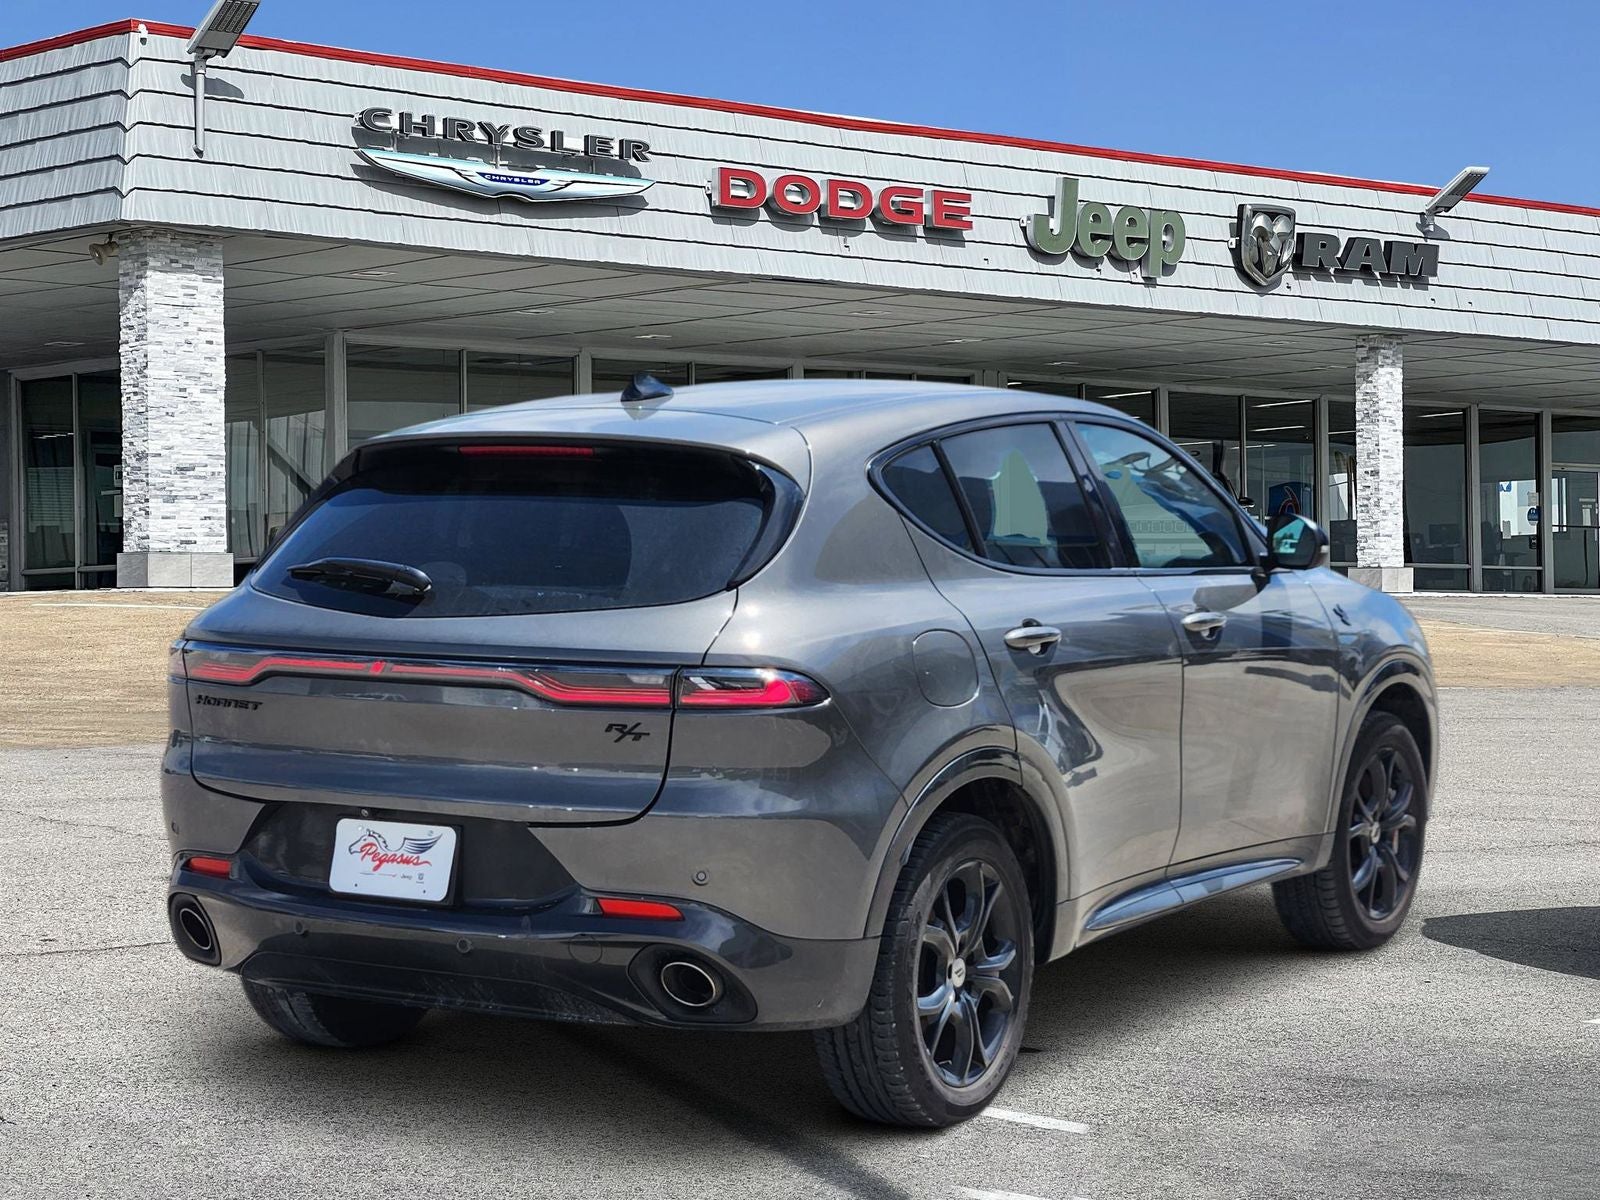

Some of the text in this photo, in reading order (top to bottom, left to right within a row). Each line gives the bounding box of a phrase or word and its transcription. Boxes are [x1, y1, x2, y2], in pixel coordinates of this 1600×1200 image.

[357, 107, 651, 162] CHRYSLER
[484, 174, 541, 185] CHRYSLER
[712, 167, 974, 231] DODGE
[1027, 177, 1187, 278] Jeep
[1299, 231, 1440, 277] RAM
[195, 694, 263, 711] HORNET
[360, 843, 432, 871] Pegasus
